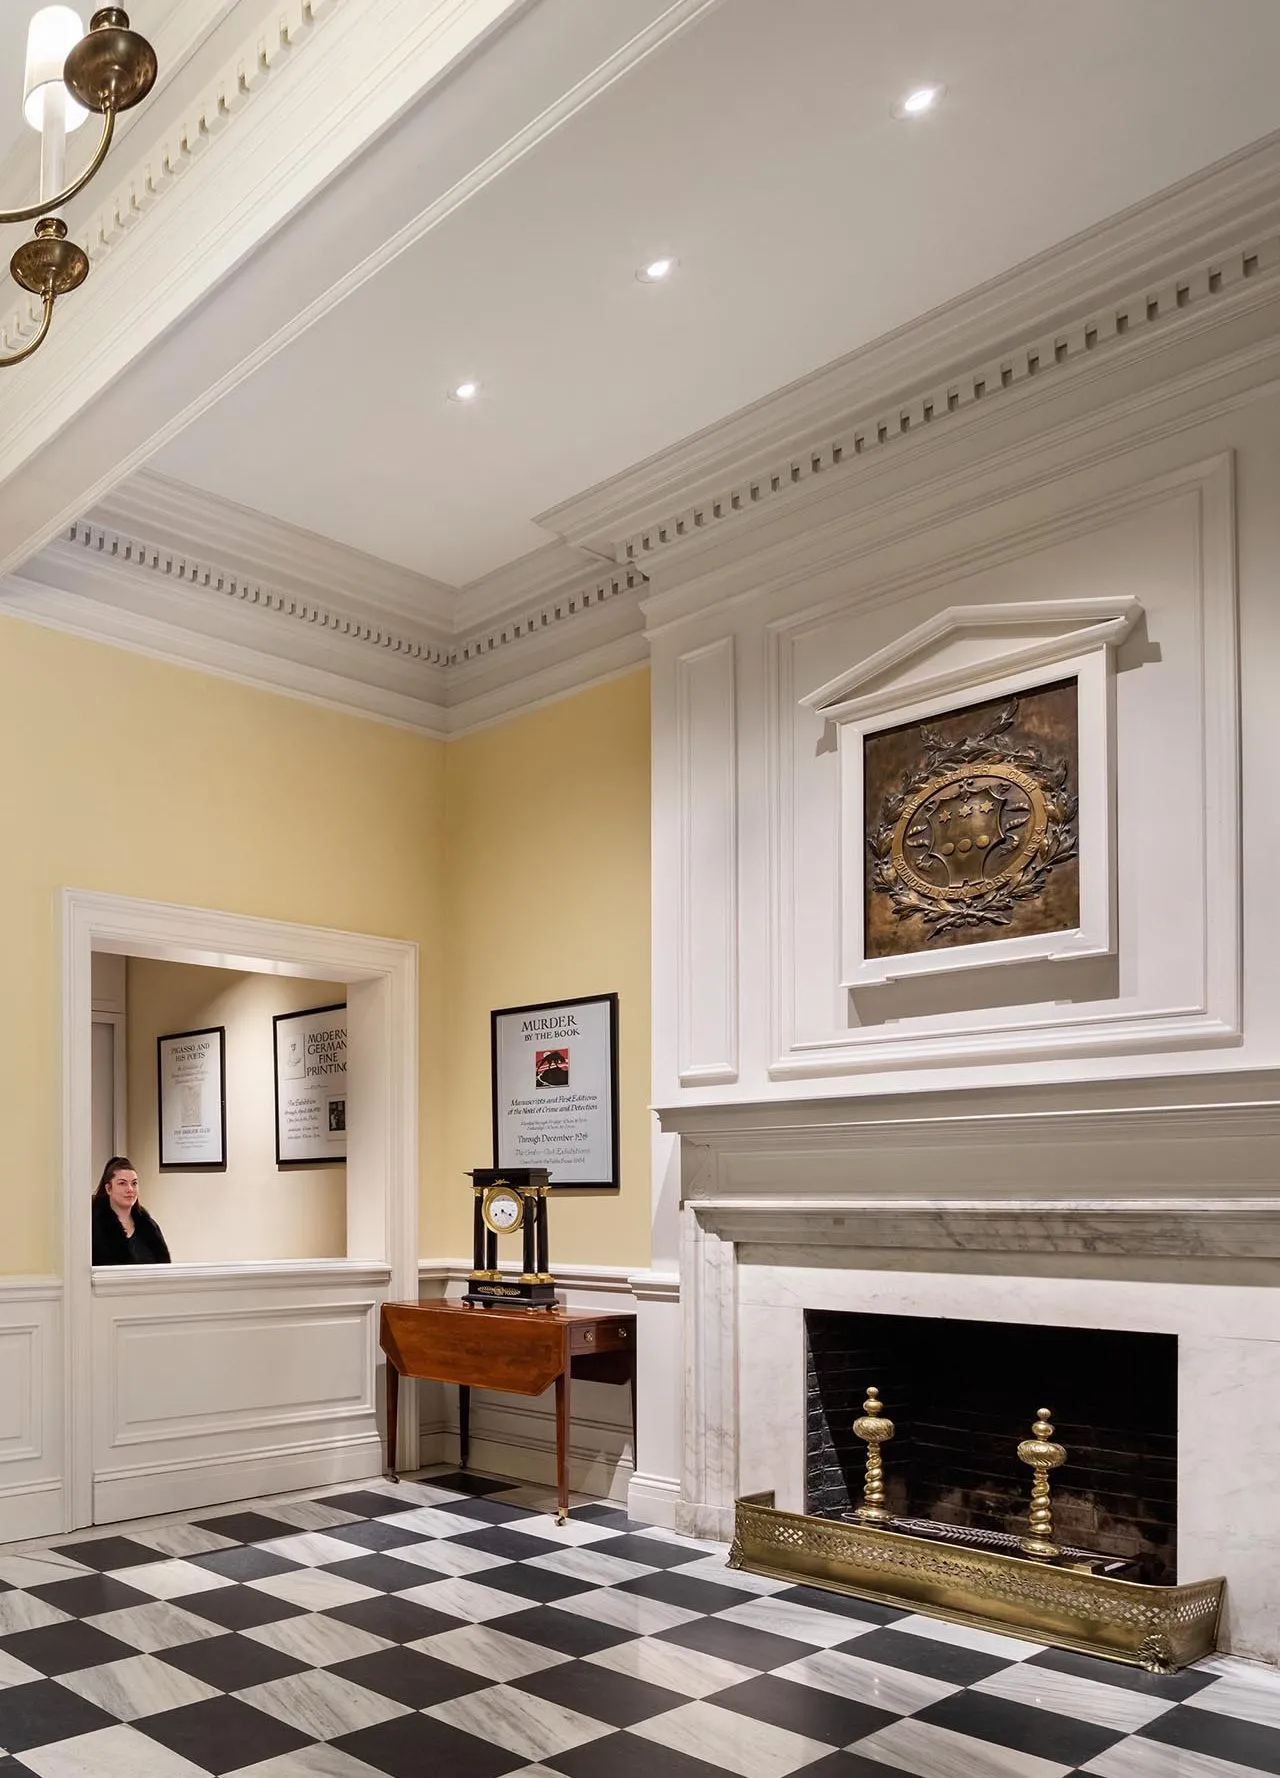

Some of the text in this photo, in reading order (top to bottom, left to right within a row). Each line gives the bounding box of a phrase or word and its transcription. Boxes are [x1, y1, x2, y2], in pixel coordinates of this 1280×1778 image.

[903, 796, 923, 819] THE
[1006, 769, 1038, 793] CLUB
[893, 825, 1045, 899] FOUNDED NEW YORK 1884
[521, 1014, 577, 1033] MURDER
[307, 1029, 347, 1044] MODERN
[524, 1028, 581, 1042] BY THE BOOK
[197, 1043, 210, 1051] AND
[307, 1040, 347, 1055] GERMAN
[318, 1052, 338, 1064] FINE
[511, 1097, 546, 1106] Manuscripts
[546, 1096, 558, 1104] and
[571, 1104, 598, 1112] Detection
[517, 1134, 541, 1145] Through
[541, 1133, 574, 1142] December
